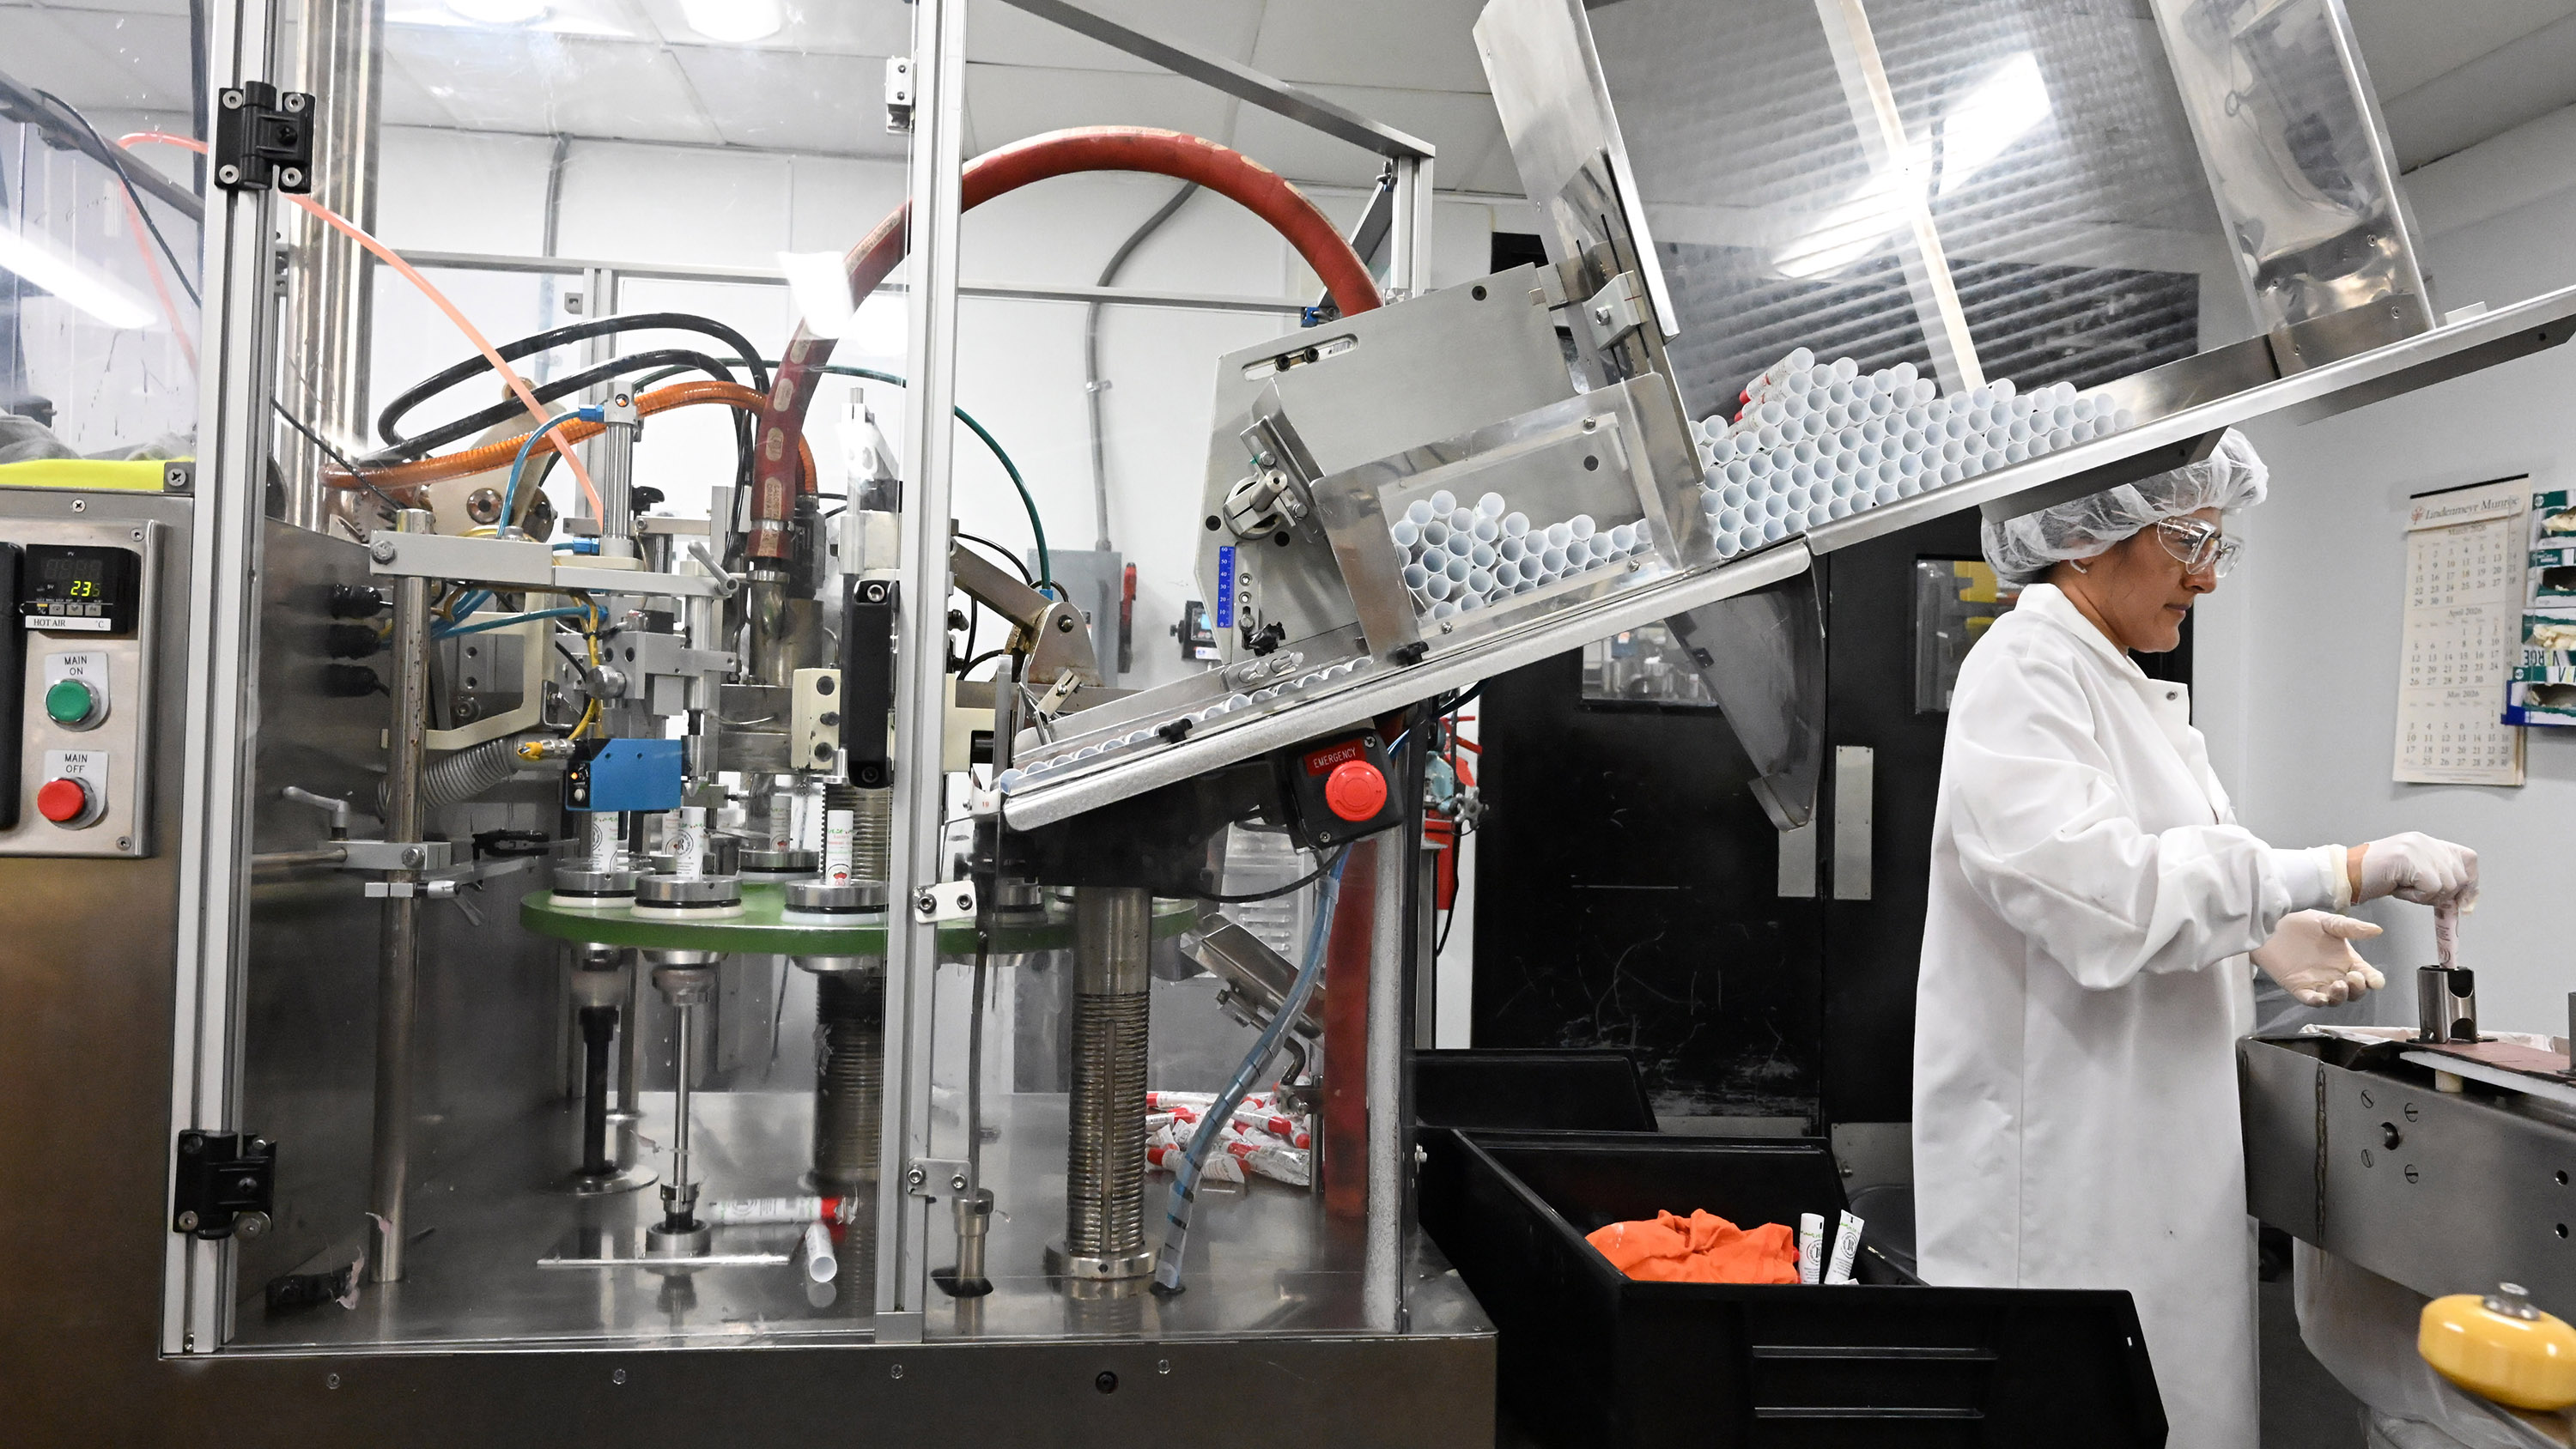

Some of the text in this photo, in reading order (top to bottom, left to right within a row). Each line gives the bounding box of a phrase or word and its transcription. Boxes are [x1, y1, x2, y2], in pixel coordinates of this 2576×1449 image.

[2448, 607, 2482, 617] April 2026
[64, 656, 88, 665] MAIN
[64, 754, 88, 762] MAIN
[1313, 747, 1357, 768] EMERGENCY
[66, 765, 85, 773] OFF
